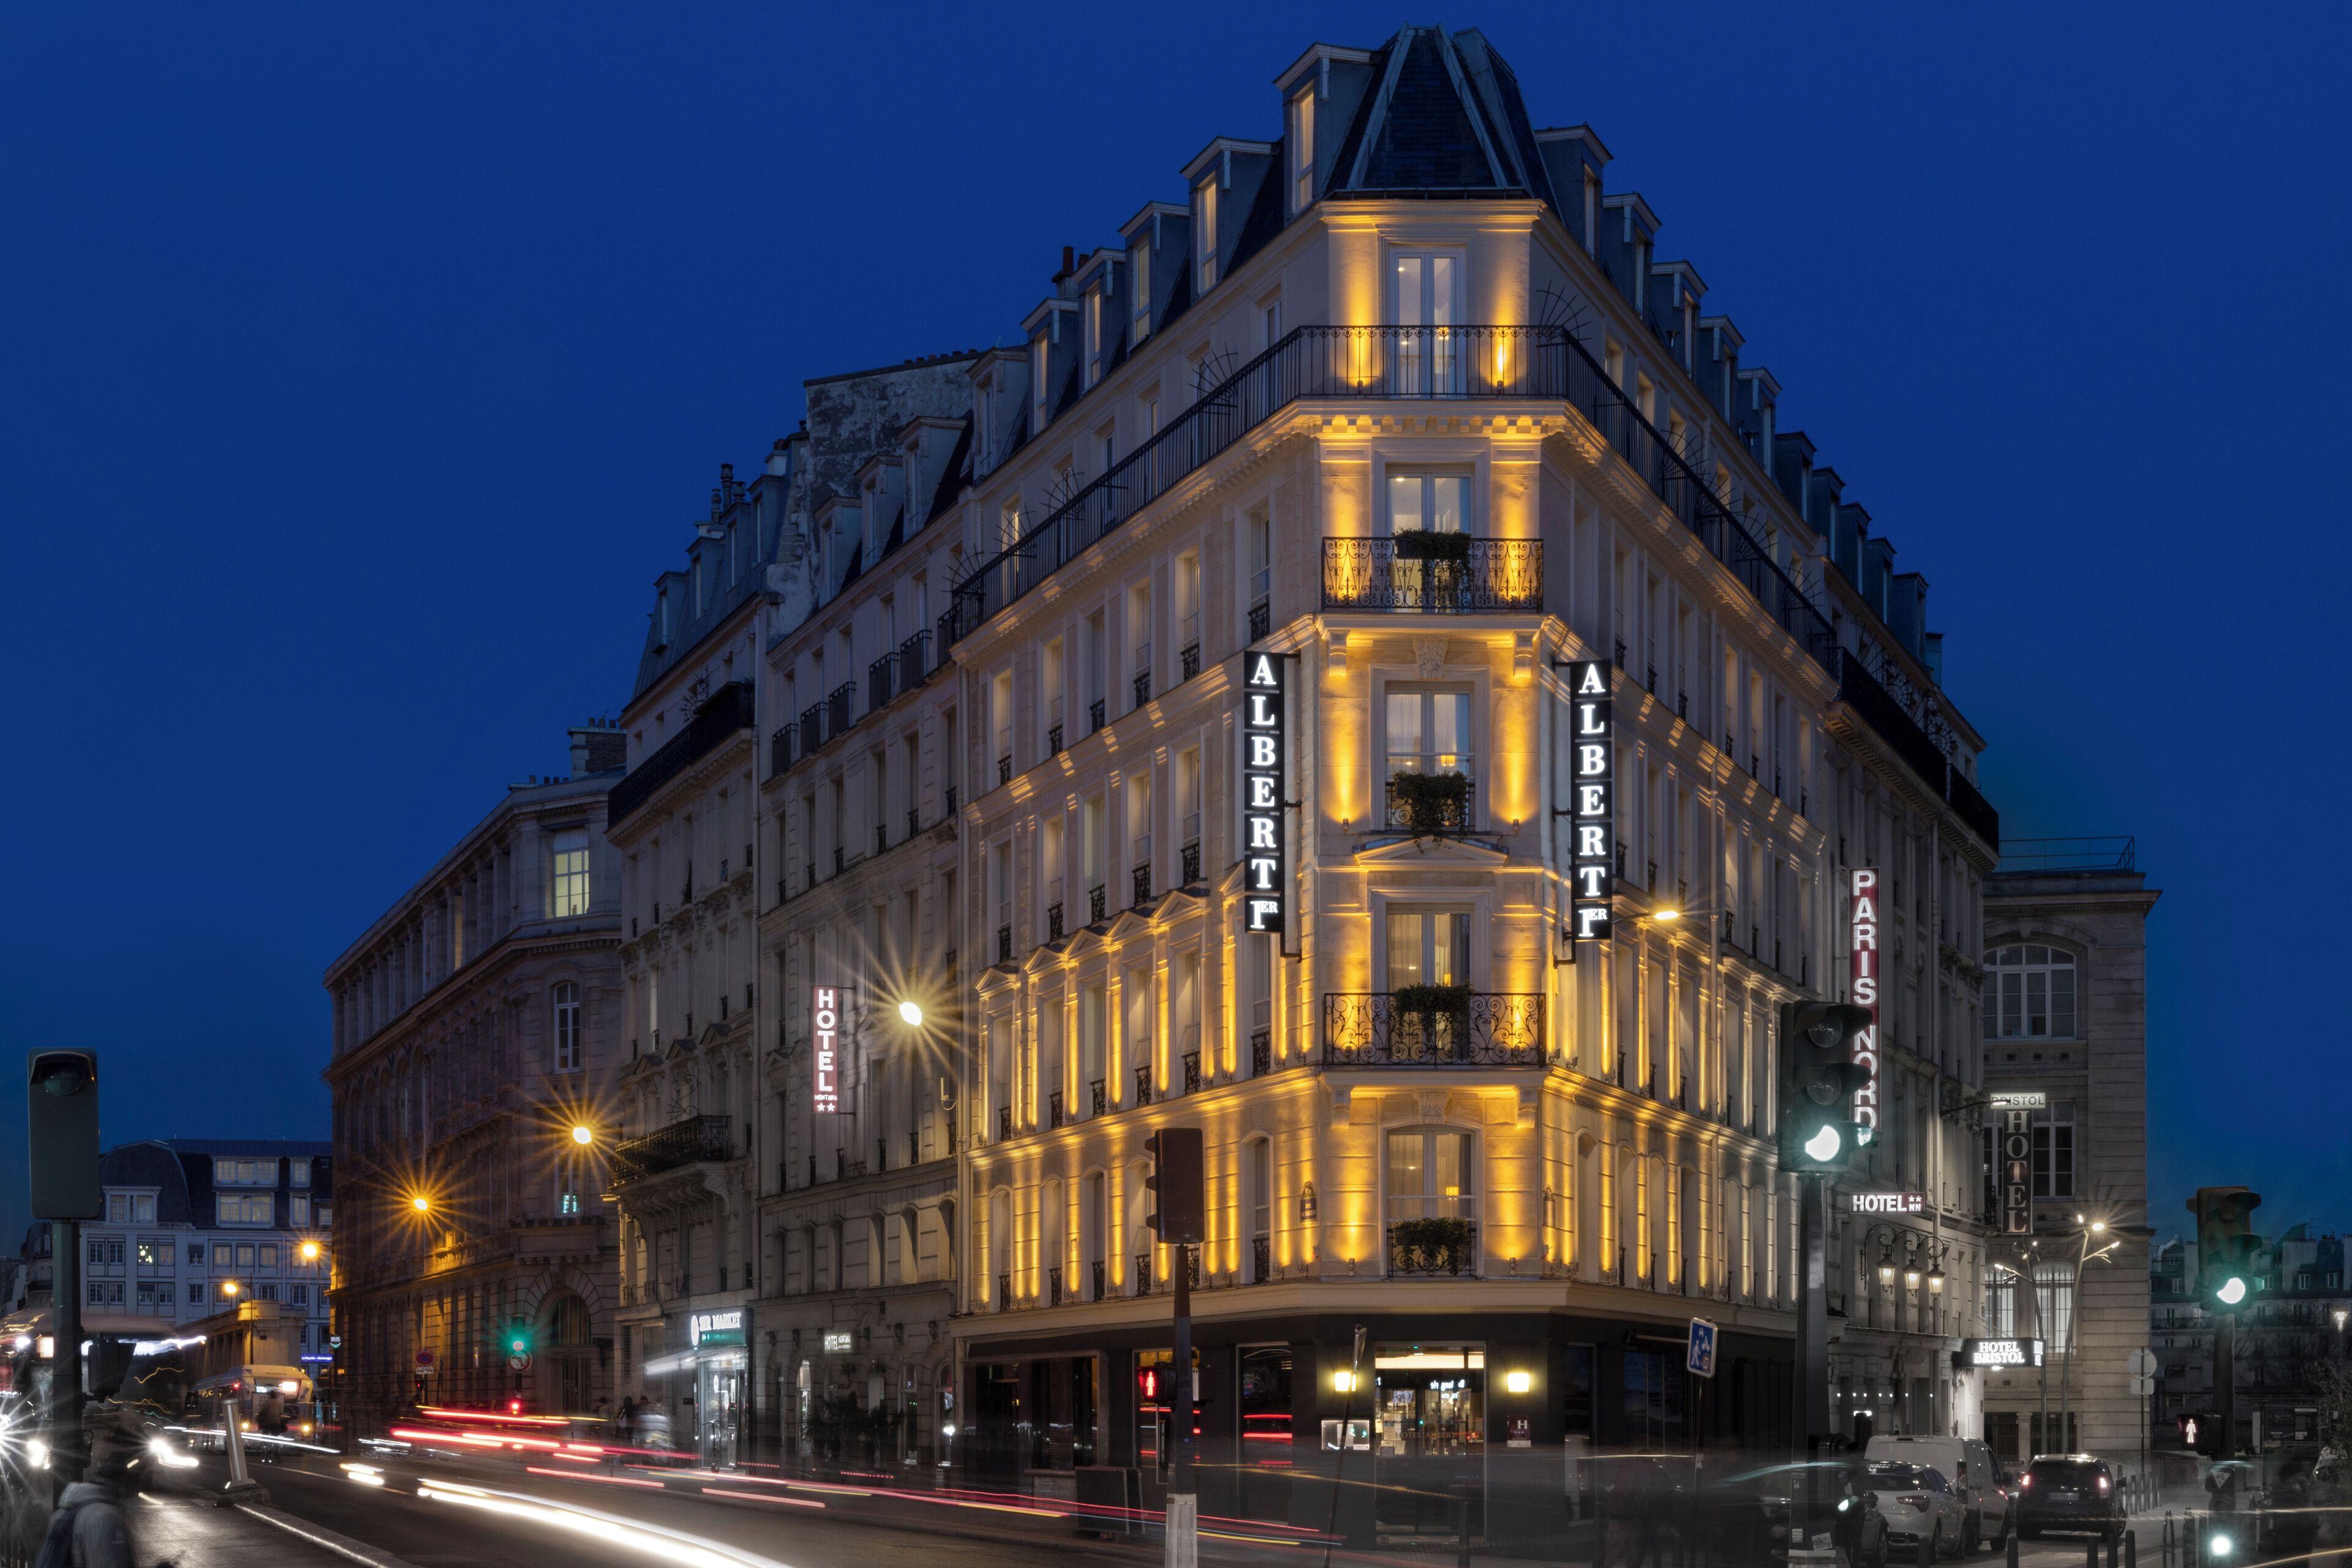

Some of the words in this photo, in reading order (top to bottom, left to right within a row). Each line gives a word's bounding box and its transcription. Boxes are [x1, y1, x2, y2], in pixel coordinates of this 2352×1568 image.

[1250, 655, 1277, 888] ALBERT
[1578, 664, 1607, 897] ALBERT
[1852, 870, 1877, 1005] PARIS
[816, 989, 835, 1091] HOTEL
[1853, 1025, 1877, 1129] NORD
[2006, 1110, 2030, 1233] HOTEL
[1853, 1195, 1907, 1212] HOTEL
[712, 1313, 741, 1330] MARKET
[824, 1335, 839, 1351] HOTEL
[1978, 1341, 2020, 1353] HOTEL
[1973, 1352, 2025, 1364] BRISTOL
[1517, 1420, 1528, 1430] H
